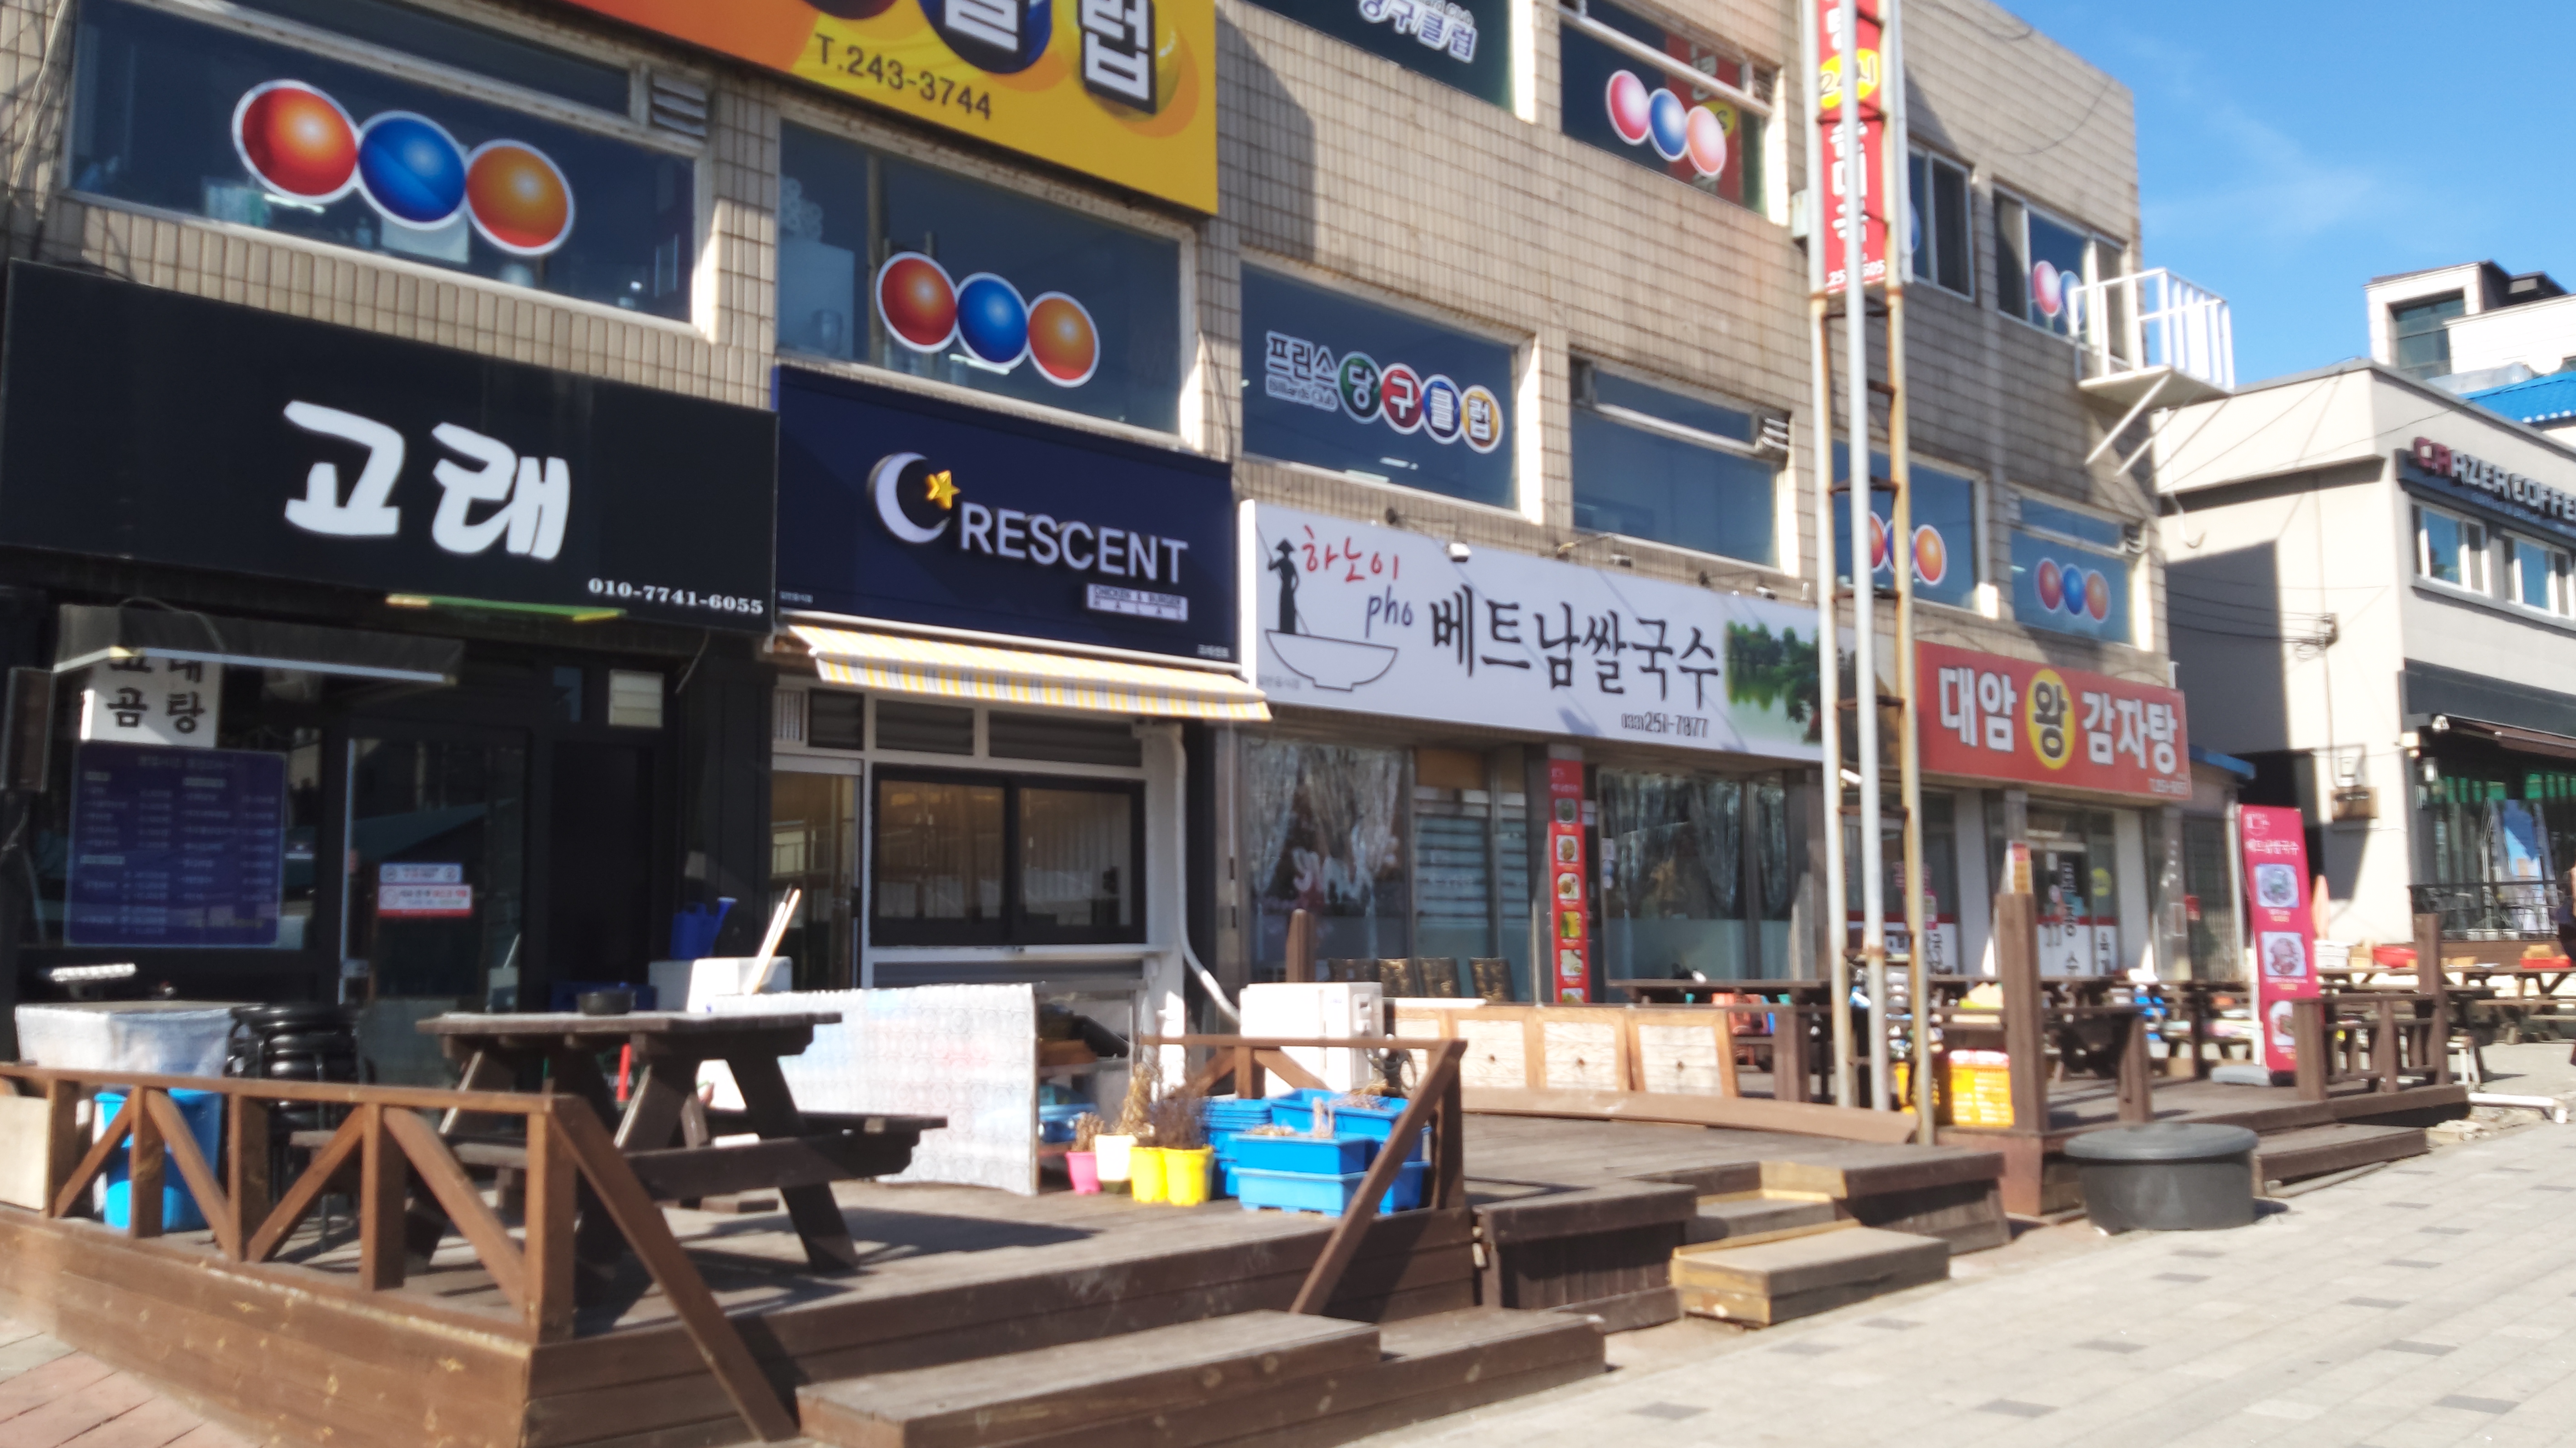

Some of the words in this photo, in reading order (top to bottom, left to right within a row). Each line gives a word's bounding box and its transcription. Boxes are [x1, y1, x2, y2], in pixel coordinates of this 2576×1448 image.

[815, 33, 992, 120] T.243-3744
[1268, 337, 1335, 382] 프린스
[1347, 364, 1492, 441] 당구클럽
[283, 400, 571, 561] 고래
[588, 577, 765, 615] 010-7741-6055
[1301, 524, 1400, 584] 하노이
[1429, 584, 1719, 710] 베트남쌀국수
[106, 686, 206, 733] 곰탕
[1937, 666, 2018, 754] 대암
[2033, 681, 2068, 759] 왕
[2082, 689, 2179, 774] 감자탕
